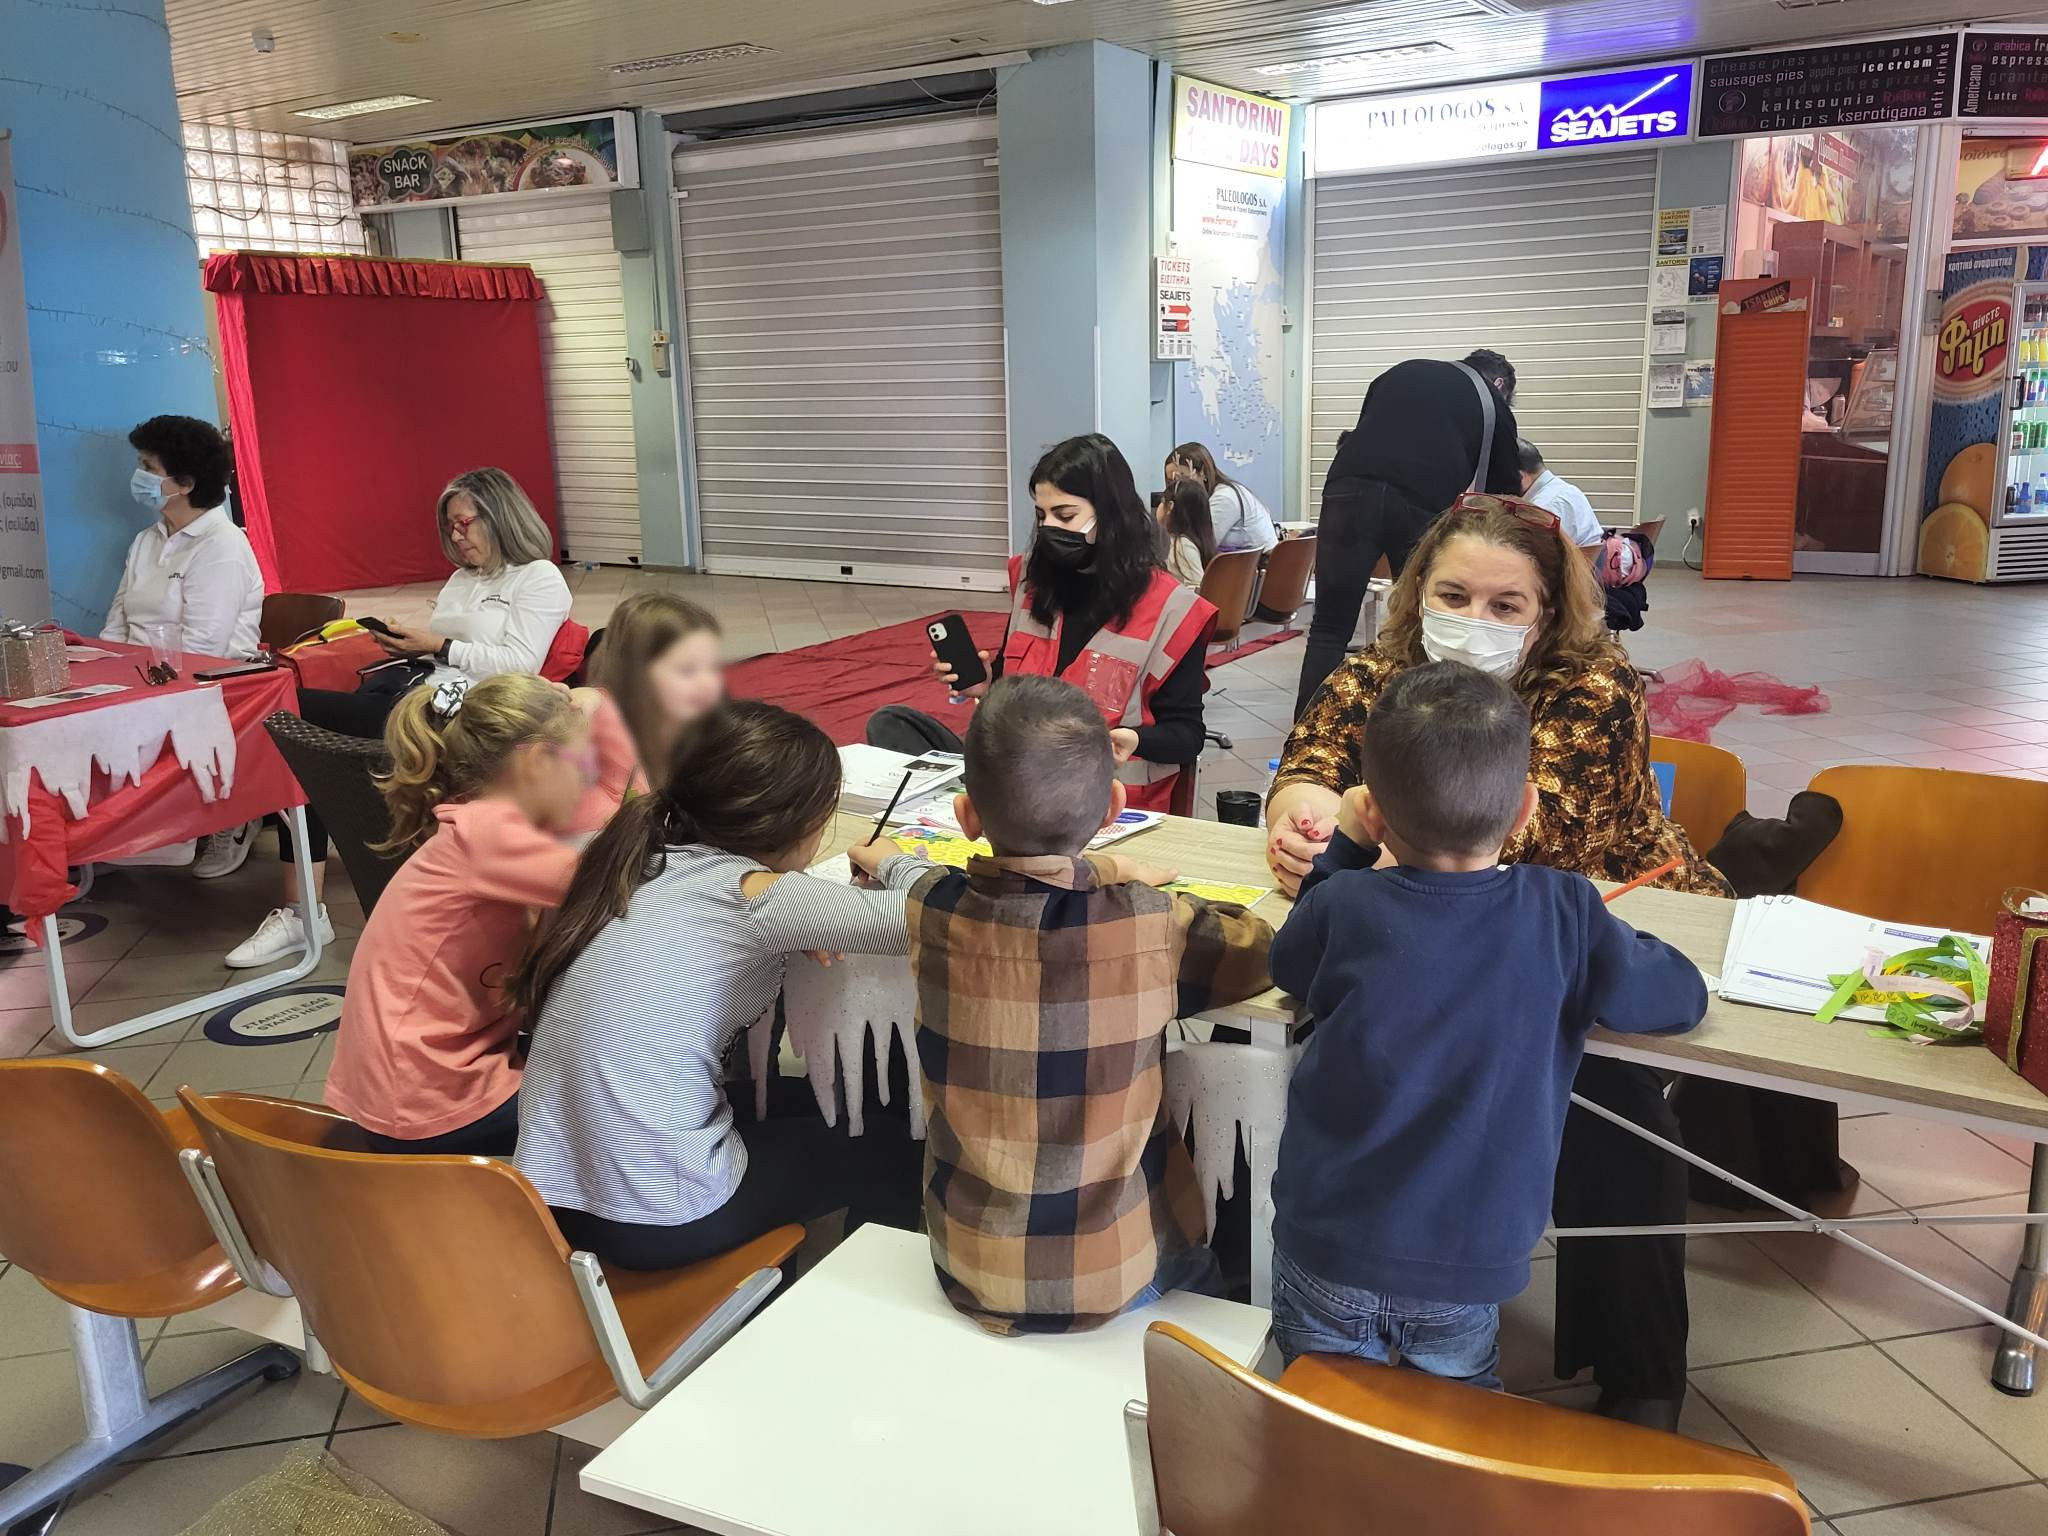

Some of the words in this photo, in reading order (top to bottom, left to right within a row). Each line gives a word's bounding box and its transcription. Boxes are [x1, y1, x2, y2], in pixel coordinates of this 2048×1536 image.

[1993, 39, 2031, 51] arabica
[1711, 60, 1766, 74] cheese
[1892, 44, 1934, 58] pies
[1933, 43, 1950, 84] drinks
[1710, 73, 1772, 88] sausages
[1776, 69, 1805, 84] pies
[1809, 63, 1835, 78] apple
[1887, 58, 1933, 71] cream
[1762, 77, 1879, 97] sandwiches
[1963, 64, 1983, 114] Americano
[1987, 90, 2018, 101] Latte
[1186, 86, 1282, 137] SANTORINI
[1761, 92, 1875, 113] kaltsounia
[1931, 91, 1944, 116] soft
[1760, 113, 1828, 129] chips
[1837, 106, 1927, 122] kserotigana
[1550, 111, 1677, 142] SEAJETS
[1240, 138, 1279, 169] DAYS
[384, 155, 428, 174] SNACK
[394, 173, 421, 189] BAR
[1216, 187, 1258, 207] PALEOLOGOS
[1160, 260, 1191, 273] TICKETS
[1160, 289, 1191, 301] SEAJETS
[1763, 294, 1785, 309] CHIPS
[0, 563, 45, 580] gmail.com
[257, 1013, 300, 1031] STAND
[300, 1001, 336, 1015] HERE
